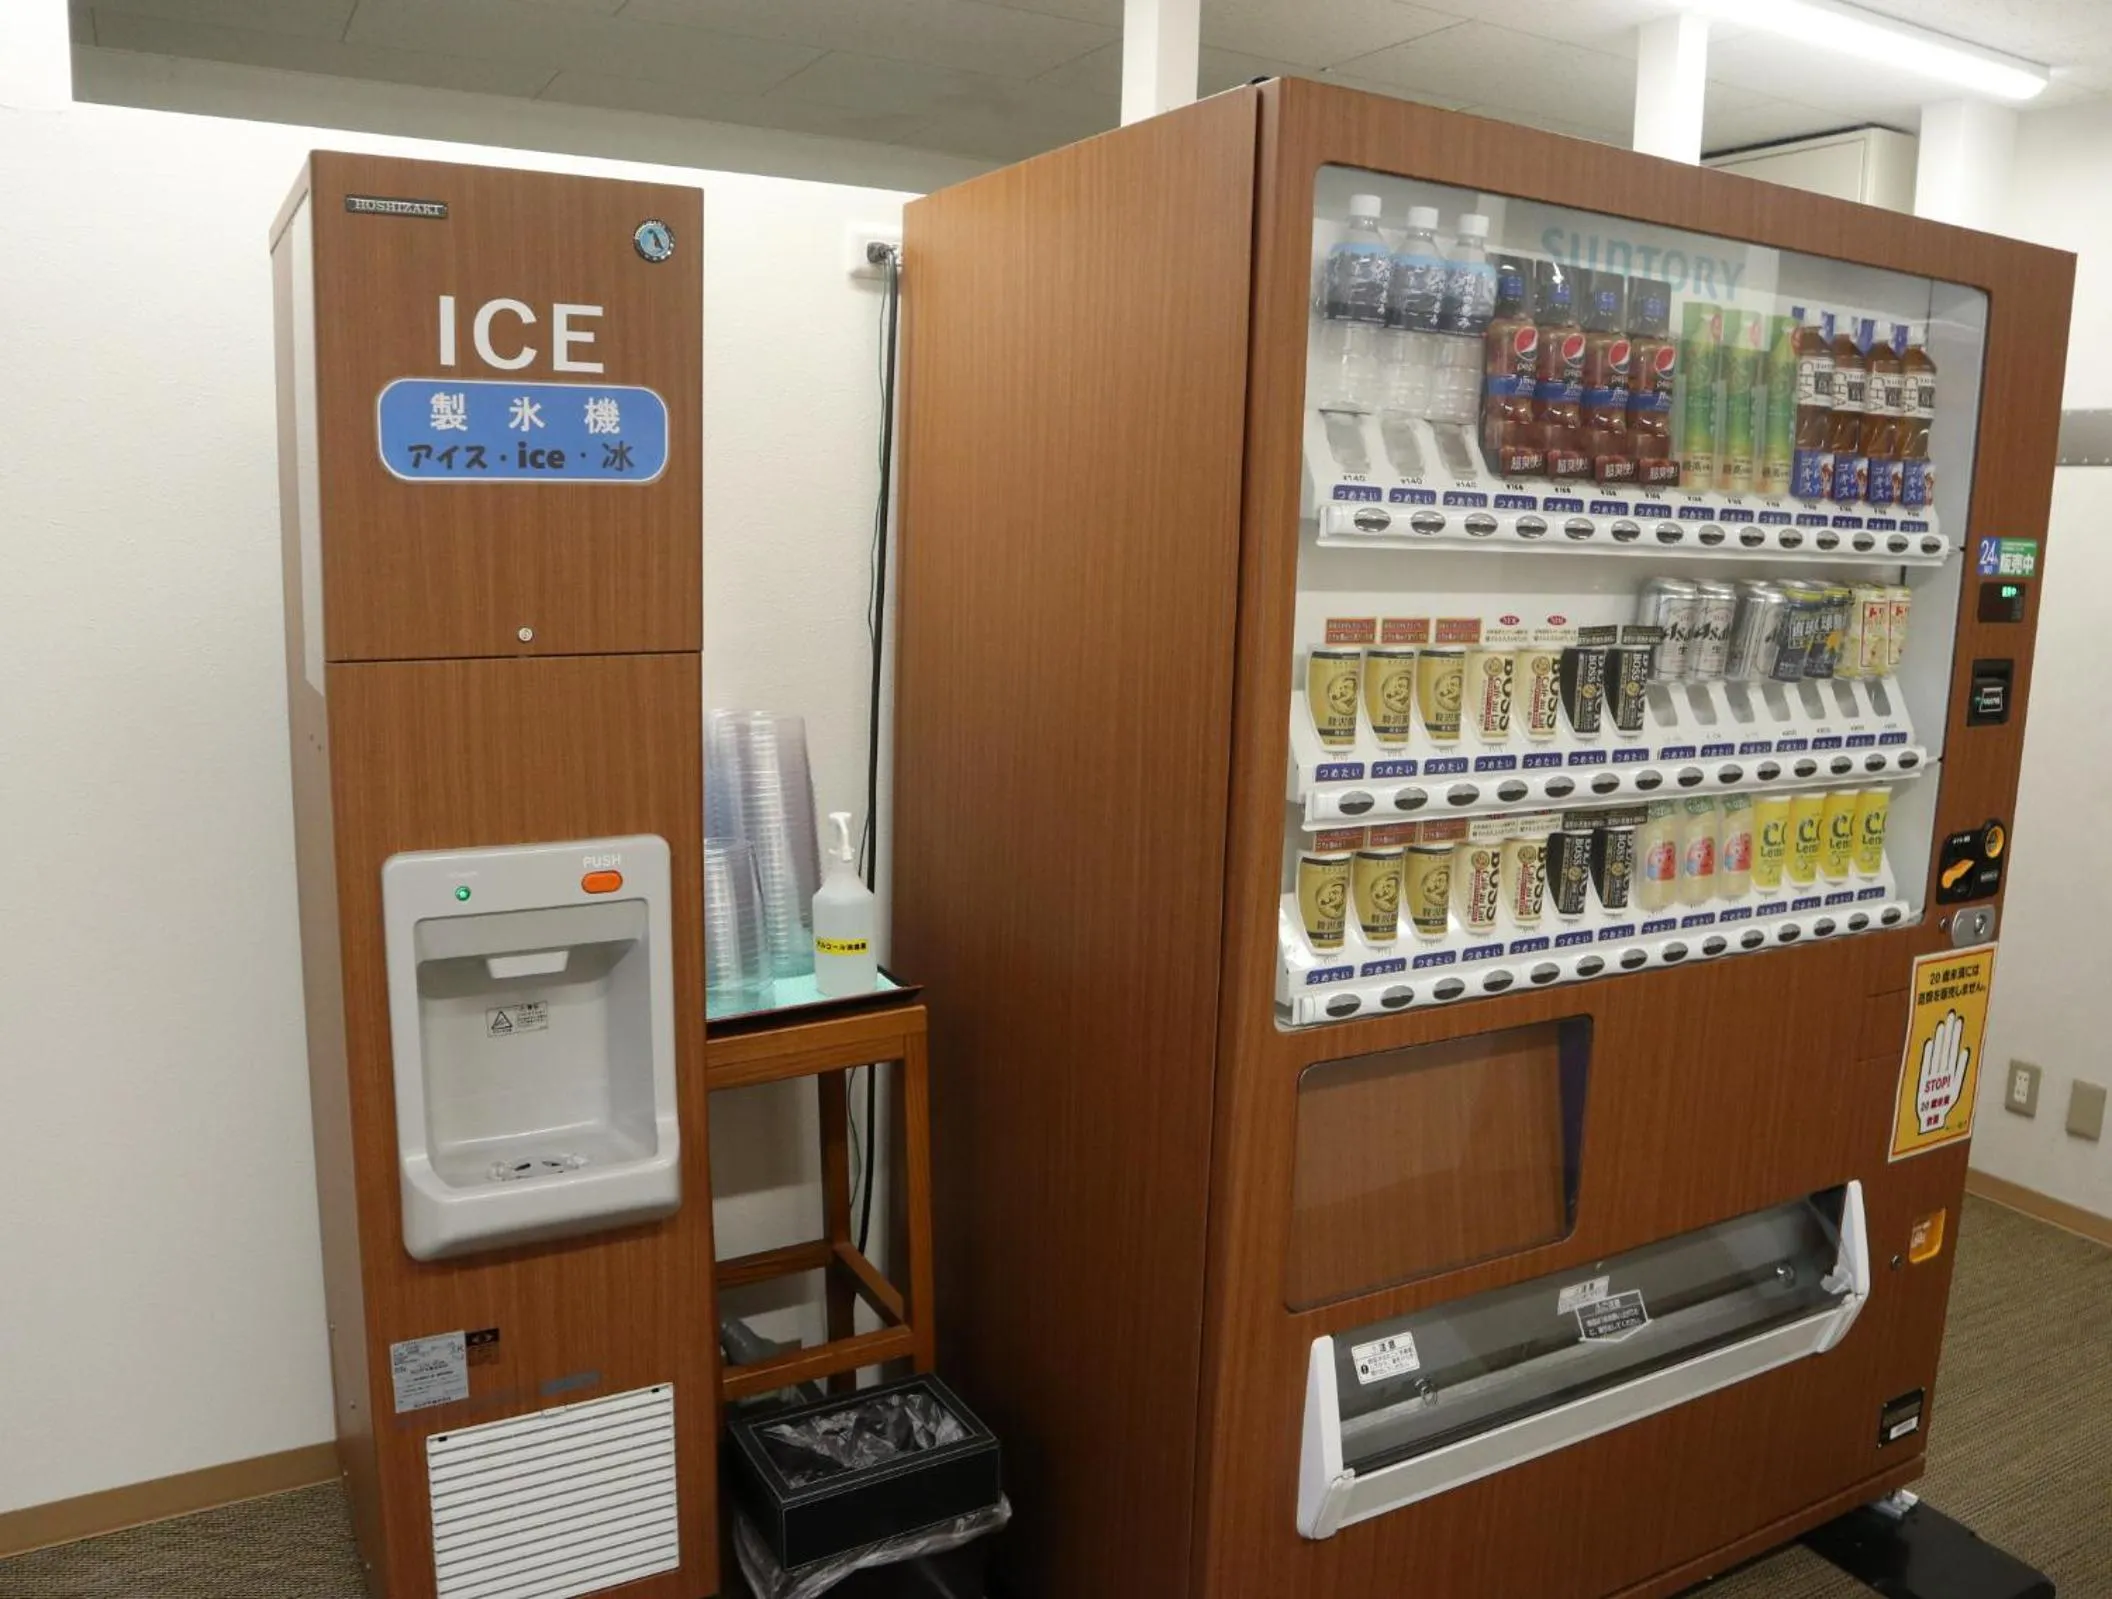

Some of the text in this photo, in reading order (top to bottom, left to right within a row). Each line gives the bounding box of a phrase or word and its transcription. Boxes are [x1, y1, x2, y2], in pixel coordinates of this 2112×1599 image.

[356, 199, 440, 215] HOSHIZAKI
[1541, 227, 1746, 300] SUNTORY
[439, 295, 604, 374] ICE
[1588, 654, 1597, 682] BOSS
[1632, 653, 1642, 680] BOSS
[1477, 759, 1514, 769] つめたい
[1526, 757, 1559, 767] つめたい
[1571, 755, 1604, 764] つめたい
[1614, 753, 1646, 762] つめたい
[1319, 768, 1360, 778] つめたい
[1375, 765, 1414, 775] つめたい
[1429, 762, 1464, 772] つめたい
[1799, 817, 1822, 842] C.
[1832, 812, 1855, 838] C.
[1865, 811, 1887, 835] C.
[1763, 821, 1787, 846] C.
[1574, 838, 1584, 864] BOSS
[1616, 834, 1627, 860] BOSS
[582, 854, 622, 868] PUSH
[1513, 941, 1547, 953] つめたい
[1558, 935, 1591, 946] つめたい
[1465, 948, 1502, 960] つめたい
[1416, 956, 1454, 968] つめたい
[1365, 964, 1403, 976] つめたい
[1310, 971, 1351, 984] つめたい
[1924, 1074, 1951, 1093] STOP!
